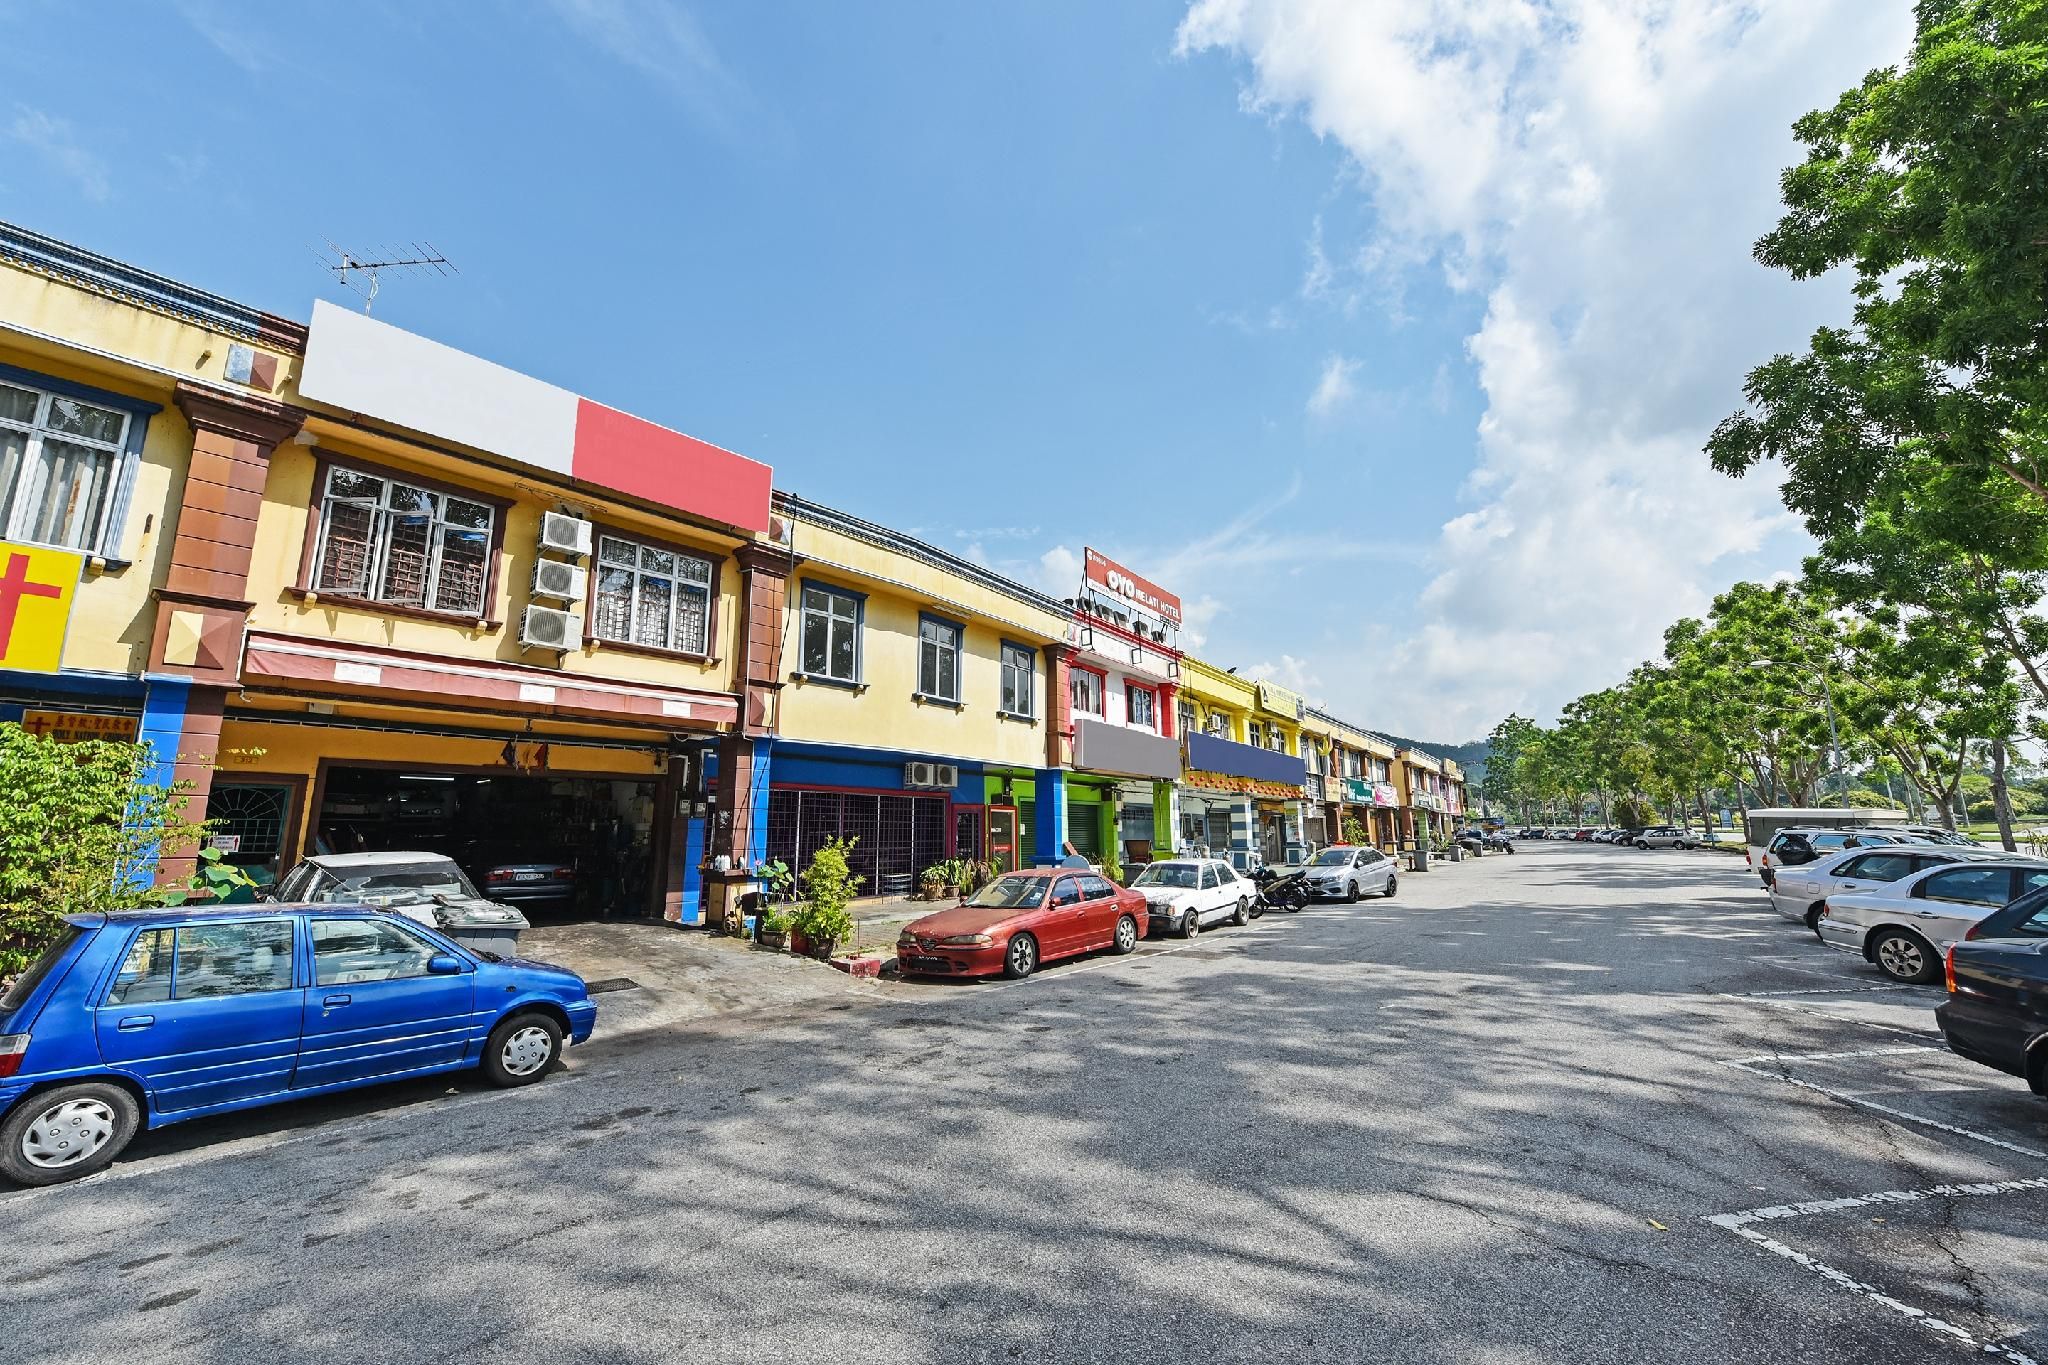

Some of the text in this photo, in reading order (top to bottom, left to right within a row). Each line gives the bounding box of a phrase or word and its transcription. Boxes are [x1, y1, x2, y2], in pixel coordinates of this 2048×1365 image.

[1107, 570, 1136, 599] OYO
[1136, 588, 1159, 608] MELATI
[1160, 600, 1180, 619] HOTEL
